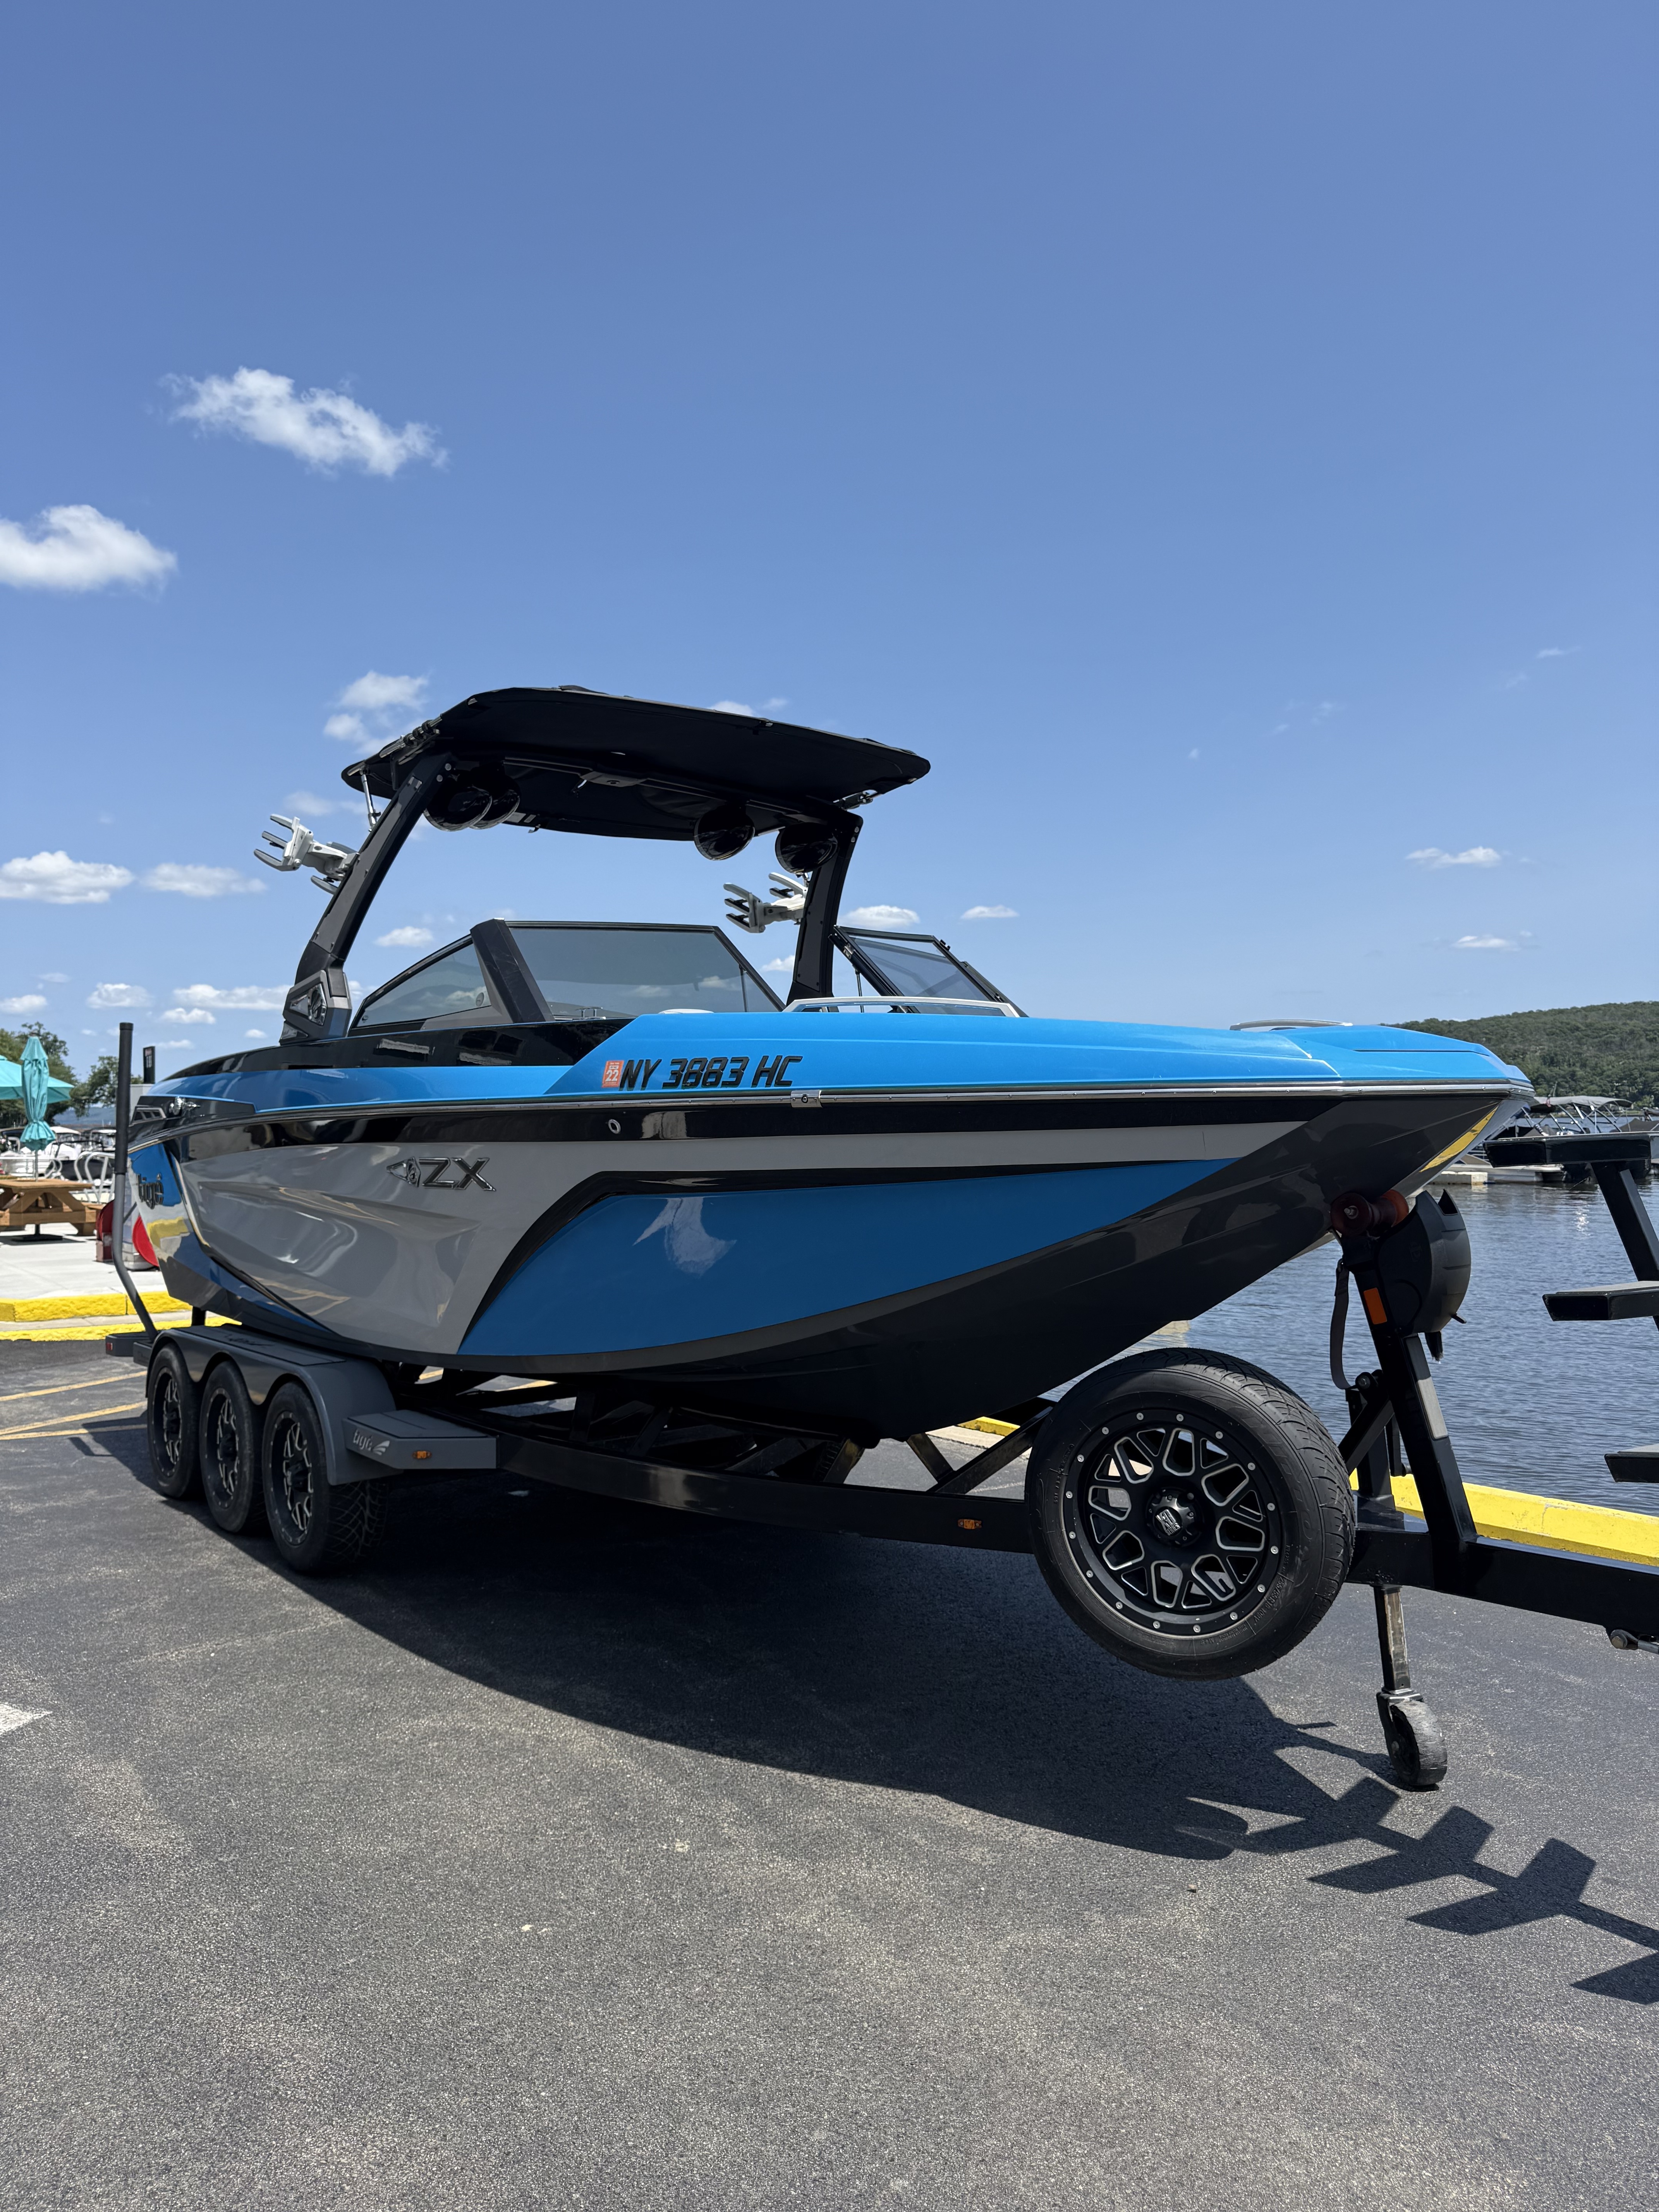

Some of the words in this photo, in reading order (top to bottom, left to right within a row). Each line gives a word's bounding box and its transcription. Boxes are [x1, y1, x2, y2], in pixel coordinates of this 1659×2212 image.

[605, 1069, 618, 1082] 22
[619, 1059, 662, 1091] NY
[662, 1056, 750, 1089] 3883
[750, 1055, 803, 1088] HC
[1155, 1509, 1176, 1533] XD
